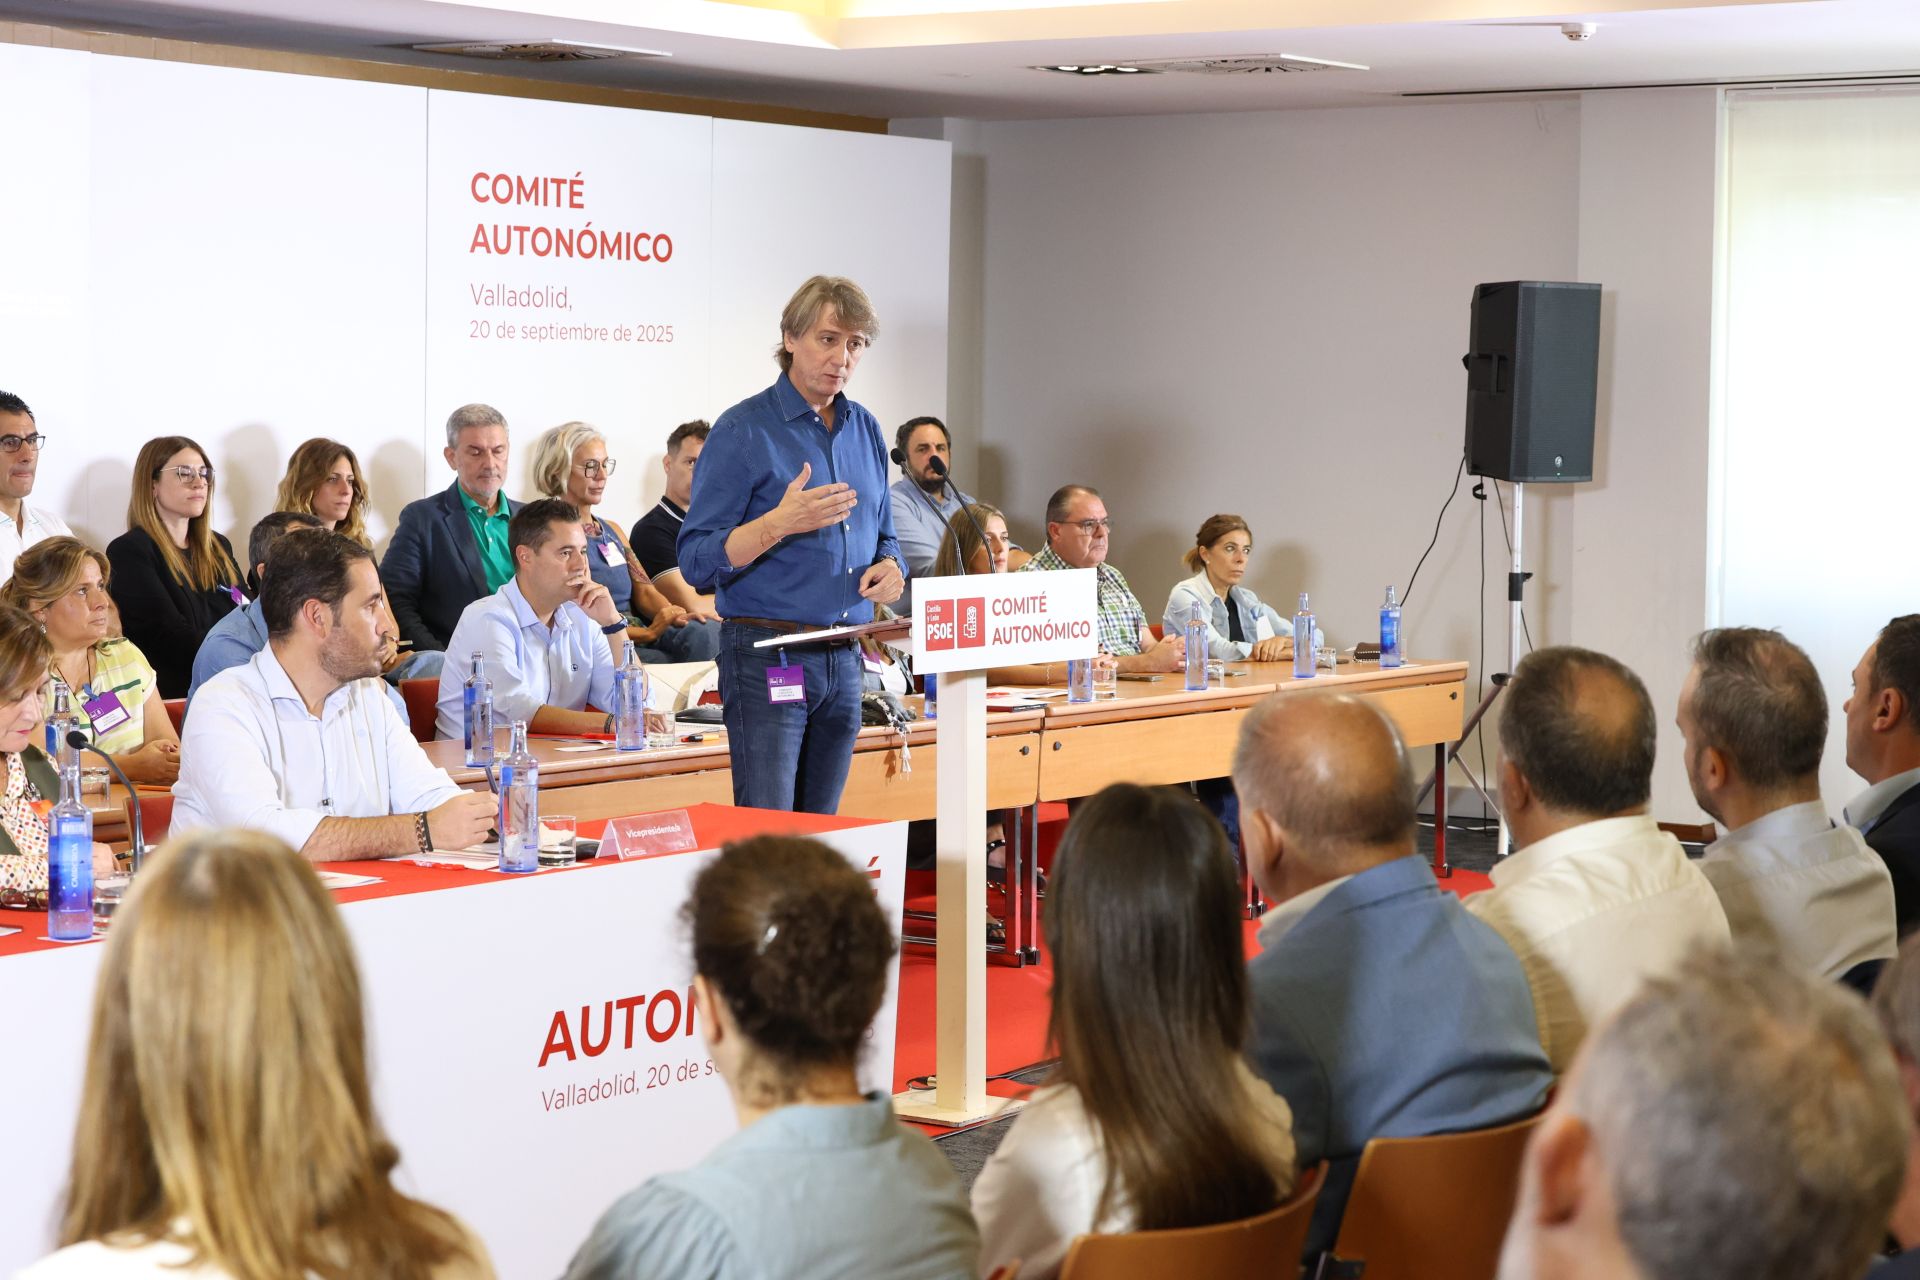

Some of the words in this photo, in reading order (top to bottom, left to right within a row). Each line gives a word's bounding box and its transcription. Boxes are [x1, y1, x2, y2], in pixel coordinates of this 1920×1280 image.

[471, 172, 584, 209] COMITÉ
[470, 222, 673, 263] AUTONÓMICO
[470, 283, 572, 311] Valladolid,
[469, 320, 490, 338] 20
[496, 320, 516, 339] de
[521, 321, 608, 343] septiembre
[613, 324, 632, 341] de
[637, 325, 674, 342] 2025
[992, 591, 1047, 616] COMITÉ
[927, 622, 953, 640] PSOE
[992, 619, 1090, 645] AUTONÓMICO
[542, 1070, 639, 1112] Valladolid,
[646, 1064, 670, 1089] 20
[676, 1058, 699, 1082] de
